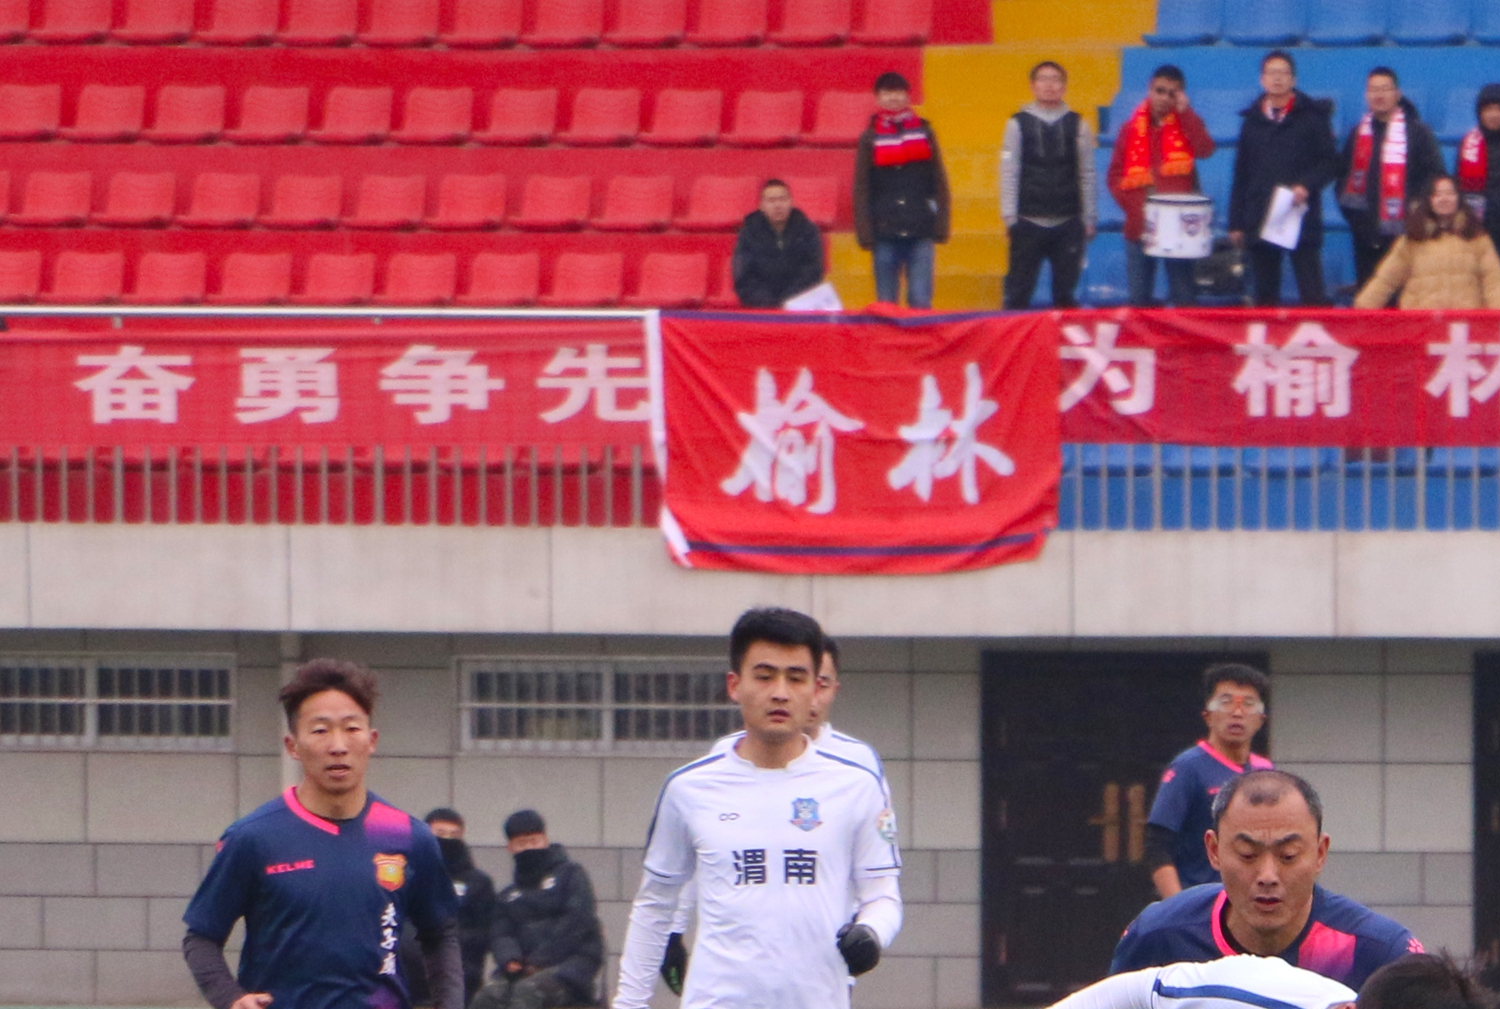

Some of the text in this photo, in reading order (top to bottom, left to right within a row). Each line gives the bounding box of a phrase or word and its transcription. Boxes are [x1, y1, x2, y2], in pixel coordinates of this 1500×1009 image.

[75, 343, 649, 426] 奋勇争先
[719, 362, 1015, 515] 榆林
[265, 860, 314, 875] KELME
[732, 848, 819, 886] 渭南
